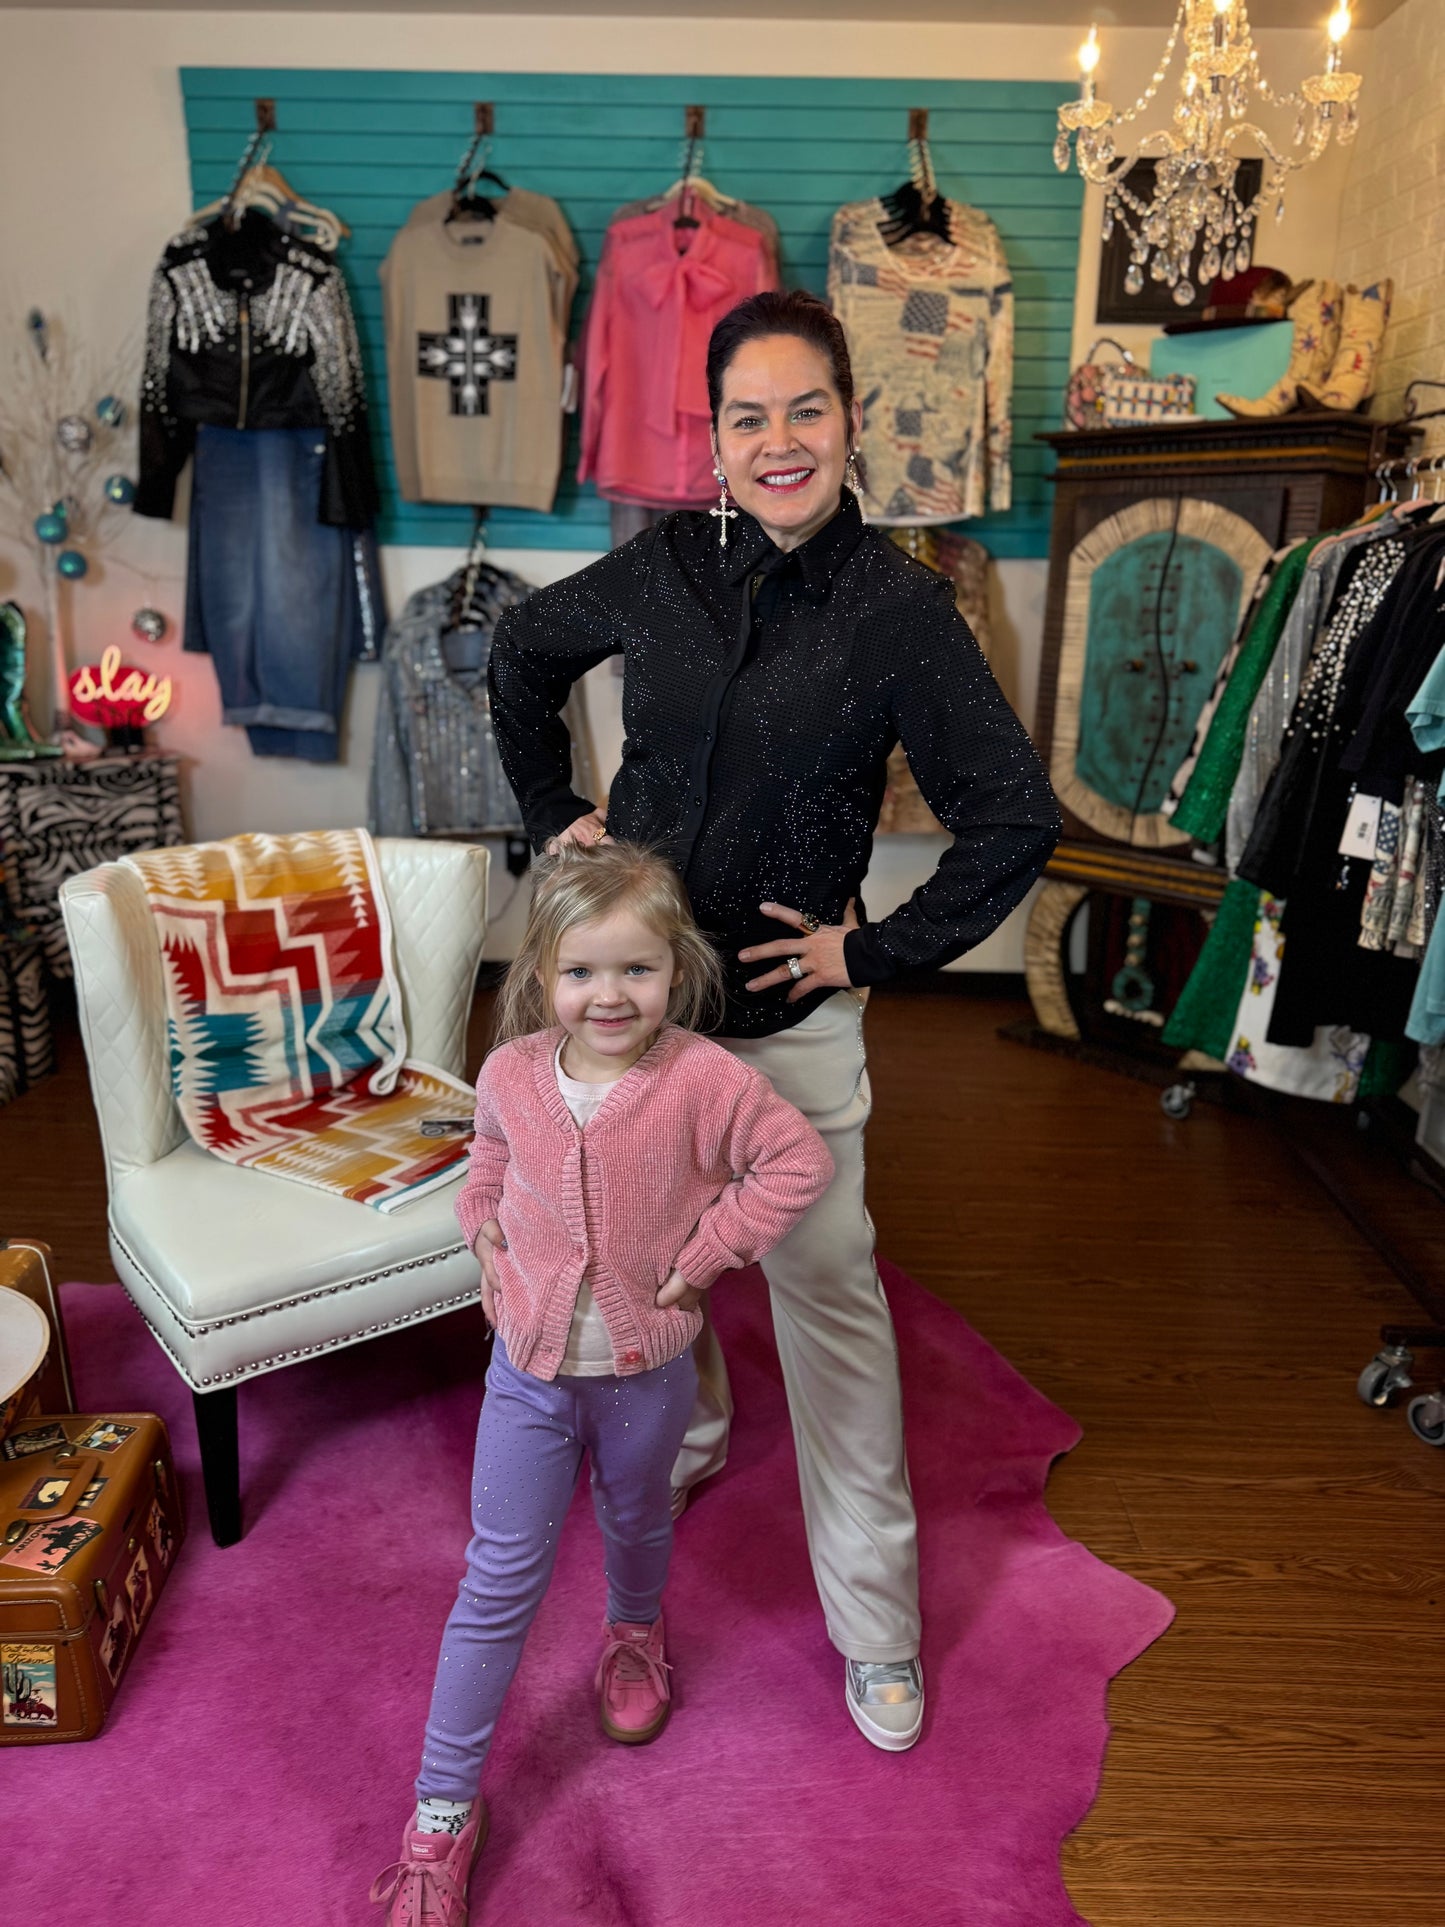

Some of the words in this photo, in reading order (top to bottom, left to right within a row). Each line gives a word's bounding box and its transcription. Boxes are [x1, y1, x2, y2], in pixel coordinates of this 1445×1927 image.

[72, 644, 172, 721] slay
[14, 1523, 50, 1553] ARIZONA
[431, 1809, 471, 1822] JESU
